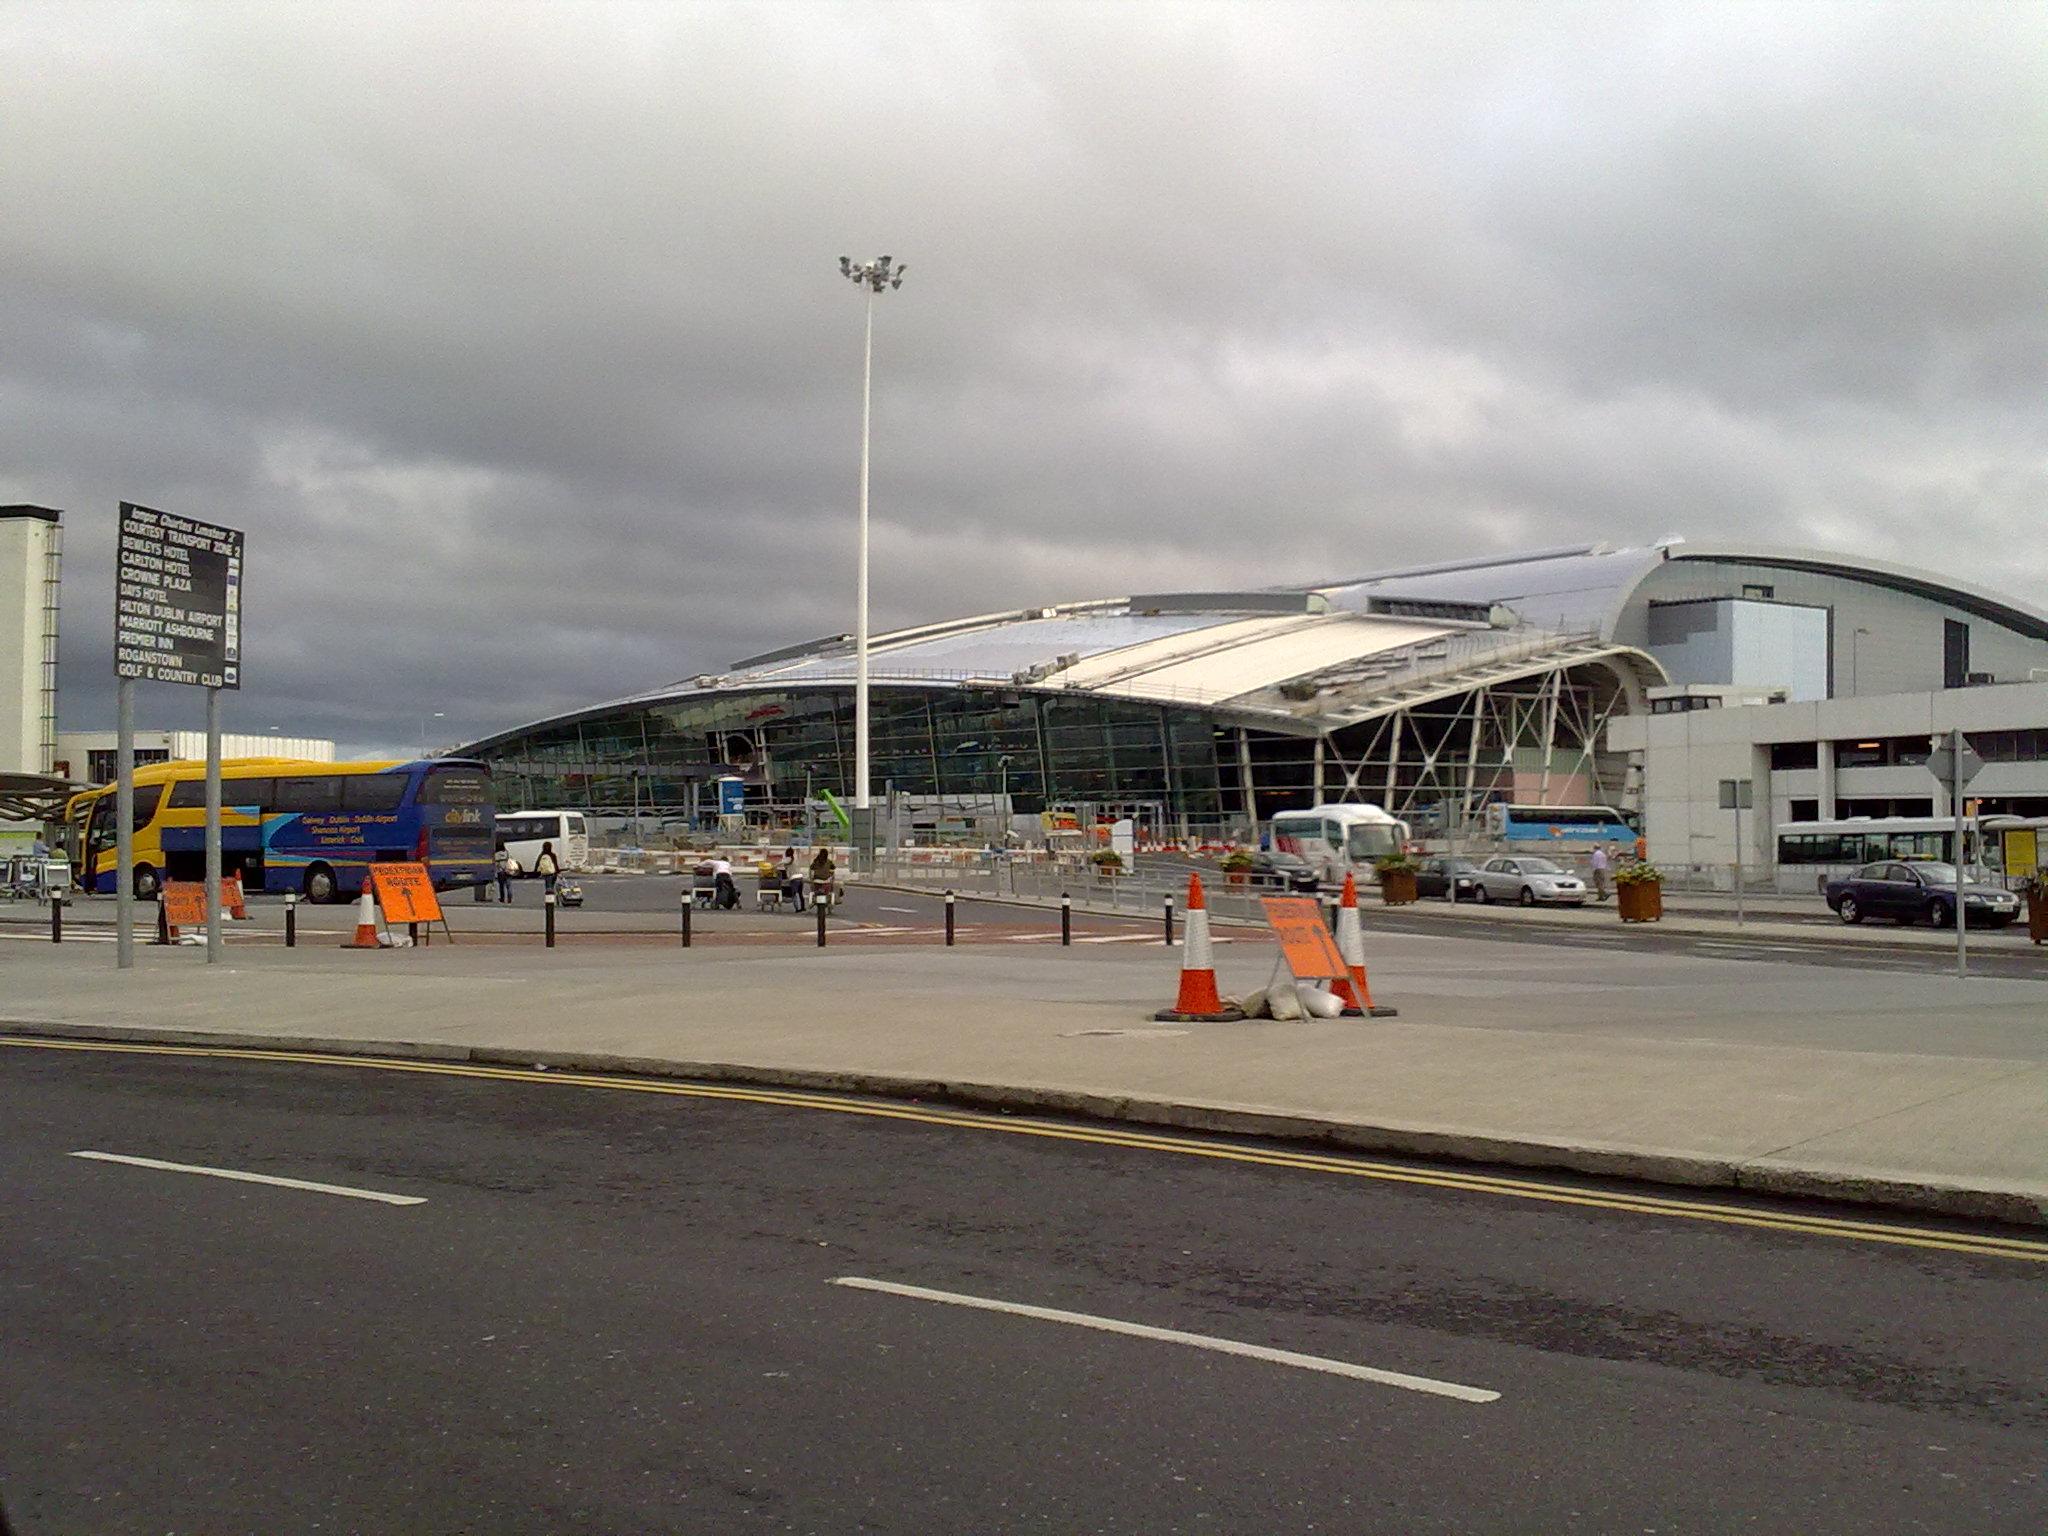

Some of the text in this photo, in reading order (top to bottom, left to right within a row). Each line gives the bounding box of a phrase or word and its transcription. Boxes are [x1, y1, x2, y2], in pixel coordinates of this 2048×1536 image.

[123, 519, 165, 540] COURTESY
[167, 529, 212, 551] TRANSPORT
[212, 541, 233, 556] ZONE
[121, 551, 192, 578] CARLTON HOTEL
[163, 545, 190, 562] HOTEL
[121, 567, 192, 592] CROWNE PLAZA
[142, 587, 168, 603] HOTEL
[120, 599, 223, 627] HILTON DUBLIN AIRPORT
[120, 614, 216, 641] MARRIOTT ASHBOURNE
[119, 630, 175, 650] PREMIER INN
[119, 647, 183, 668] ROGANSTOWN
[119, 663, 223, 687] GOLF & COUNTRY CLUB
